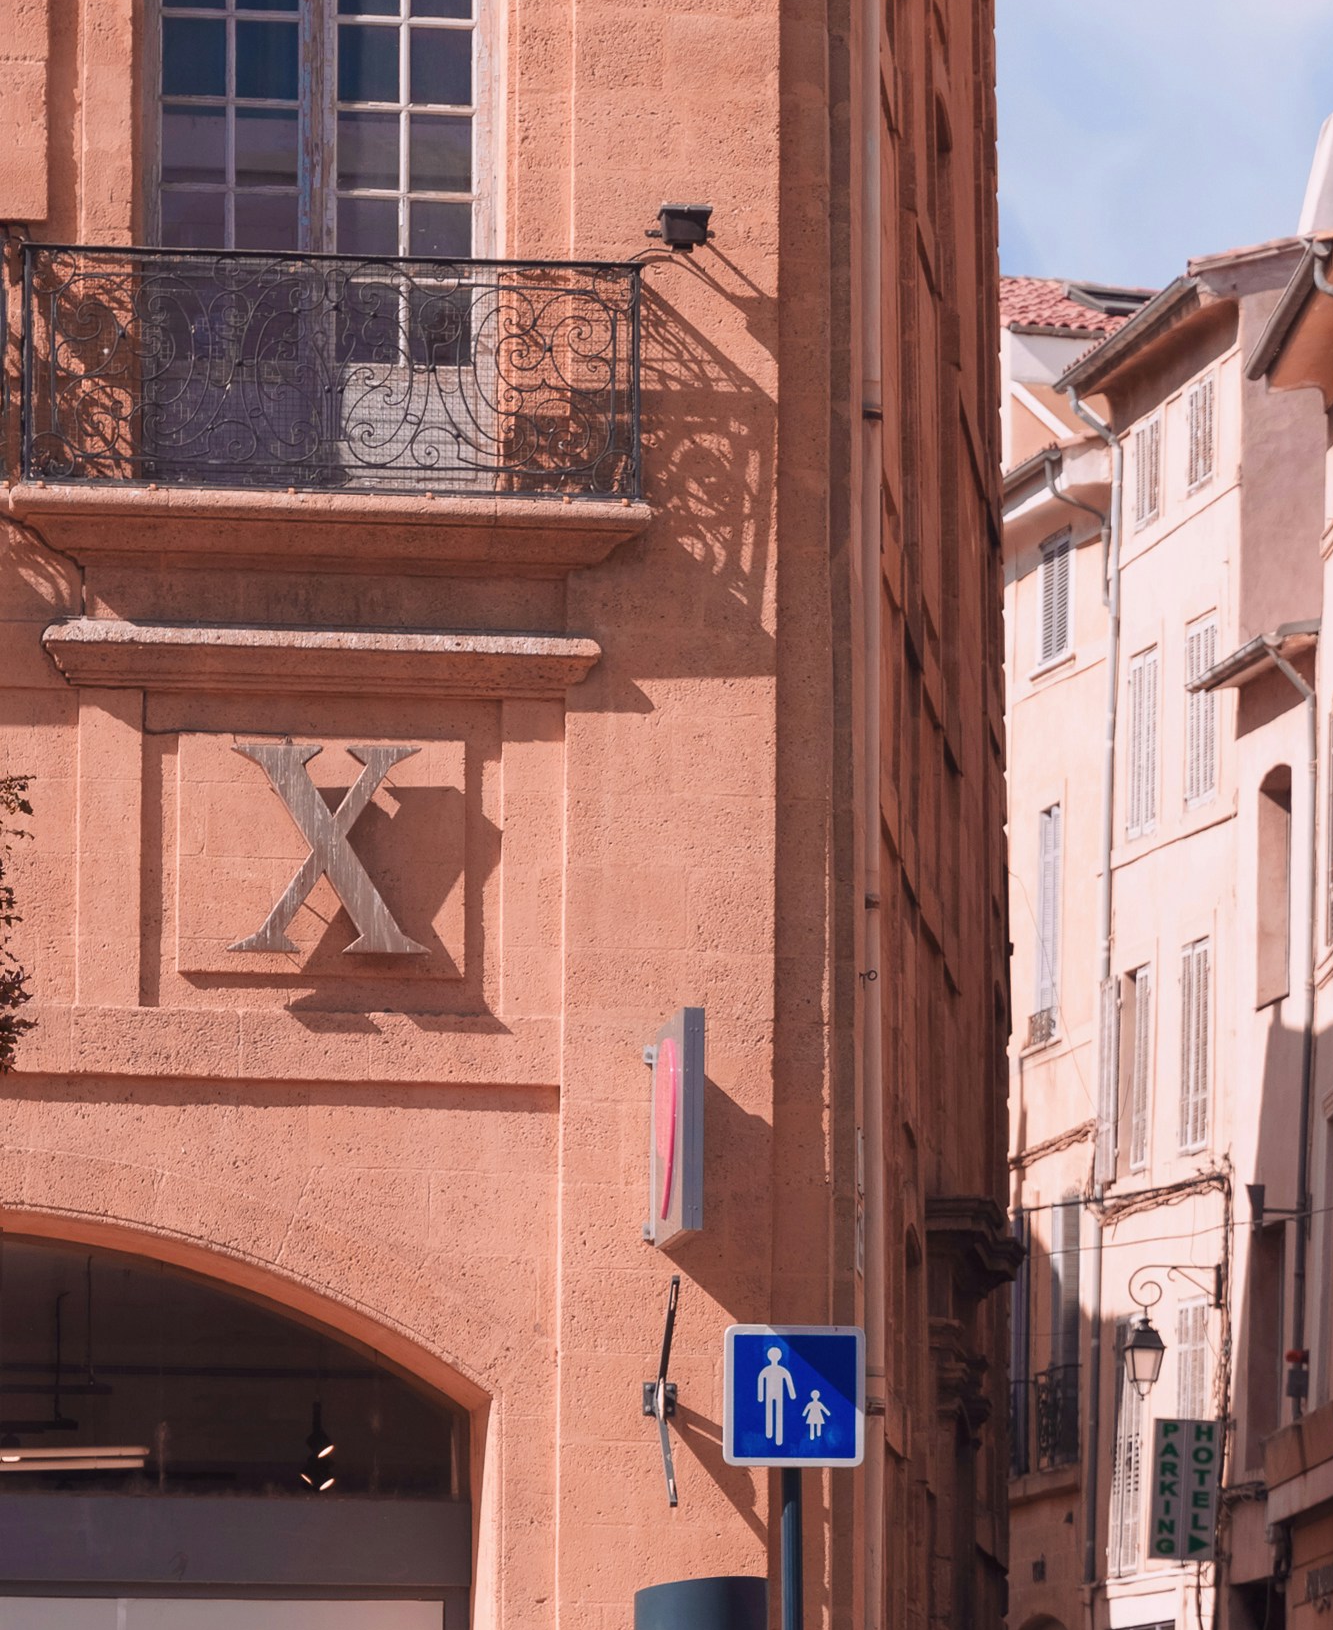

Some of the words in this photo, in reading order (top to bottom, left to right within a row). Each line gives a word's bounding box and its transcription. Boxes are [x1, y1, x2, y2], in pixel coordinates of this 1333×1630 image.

[227, 744, 433, 955] X
[1155, 1422, 1180, 1555] PARKING
[1191, 1423, 1214, 1531] HOTEL
